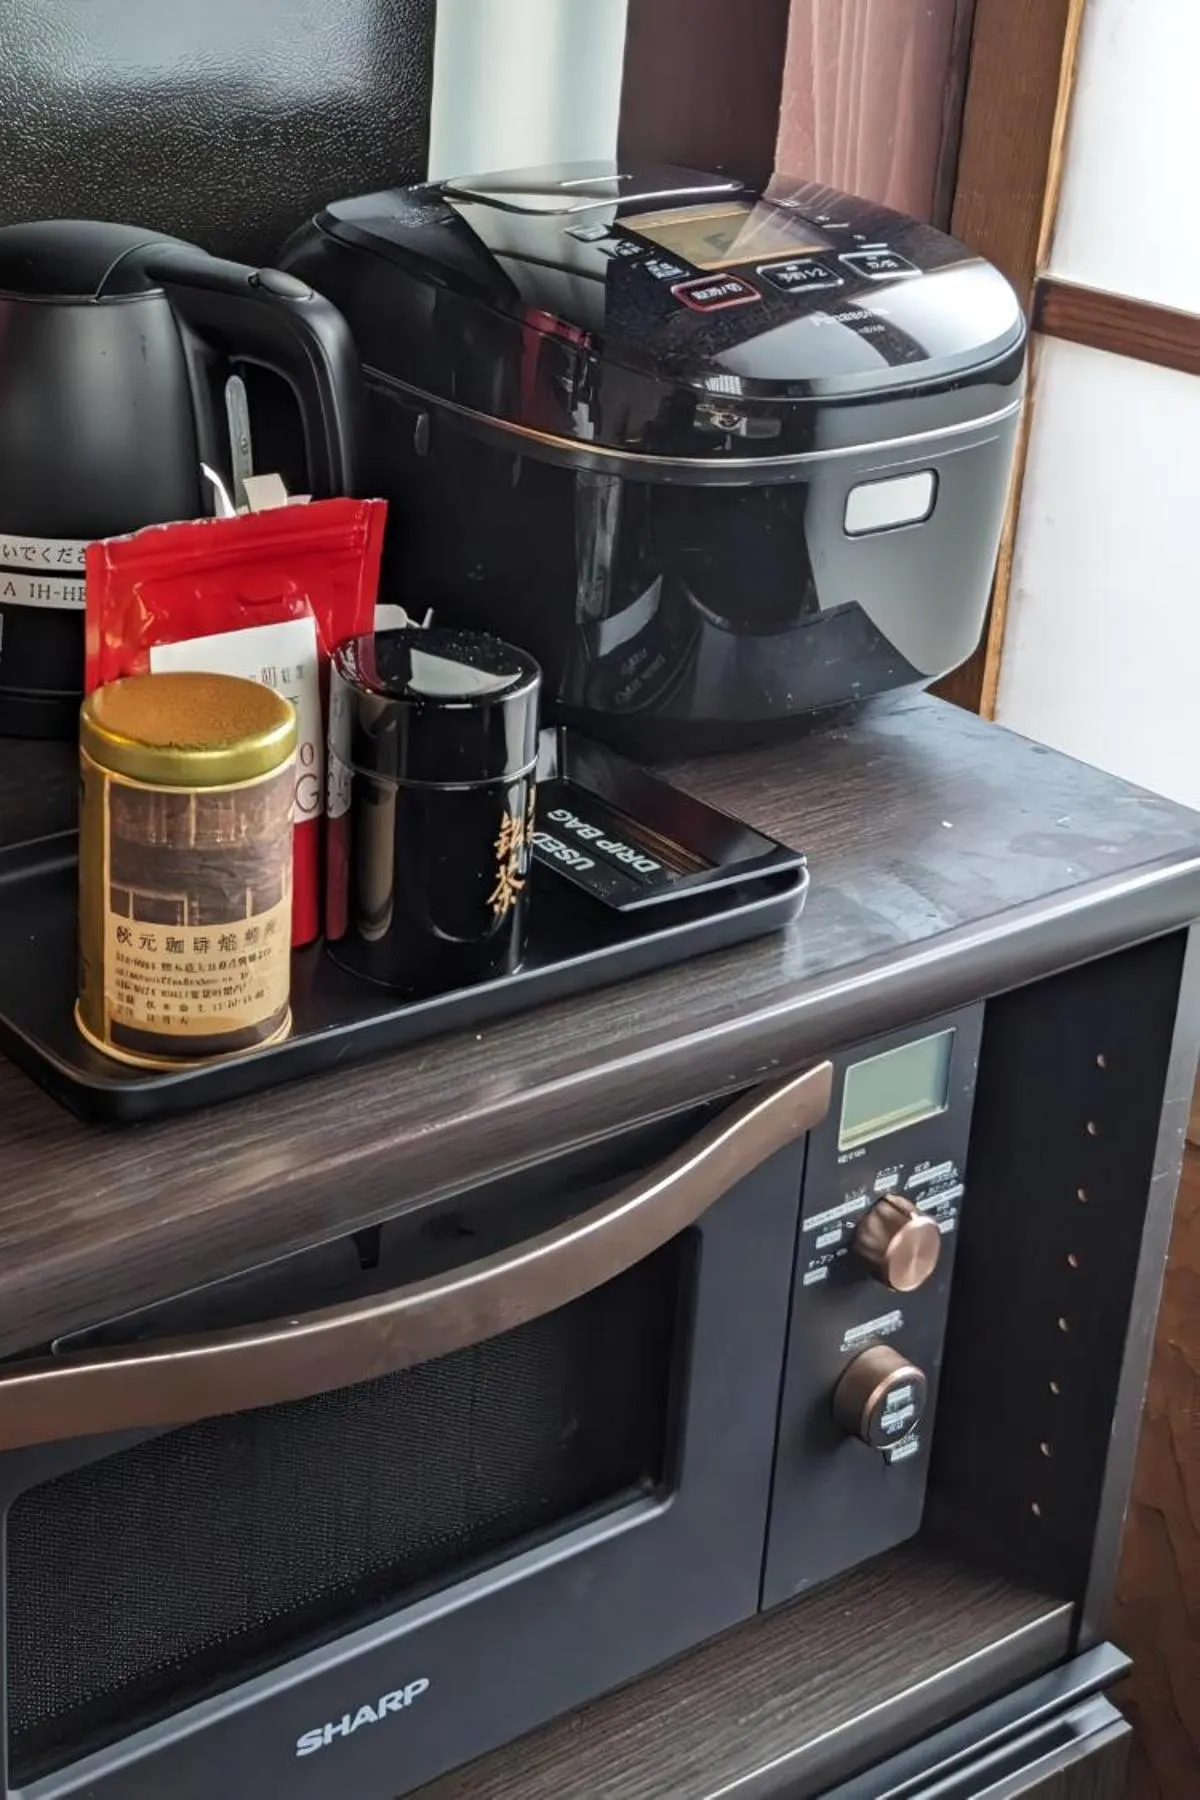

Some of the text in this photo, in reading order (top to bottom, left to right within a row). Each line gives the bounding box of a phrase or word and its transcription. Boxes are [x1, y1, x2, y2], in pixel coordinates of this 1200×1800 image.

[3, 581, 16, 596] A
[547, 808, 662, 873] DRIP BAG
[296, 1677, 430, 1757] SHARP
